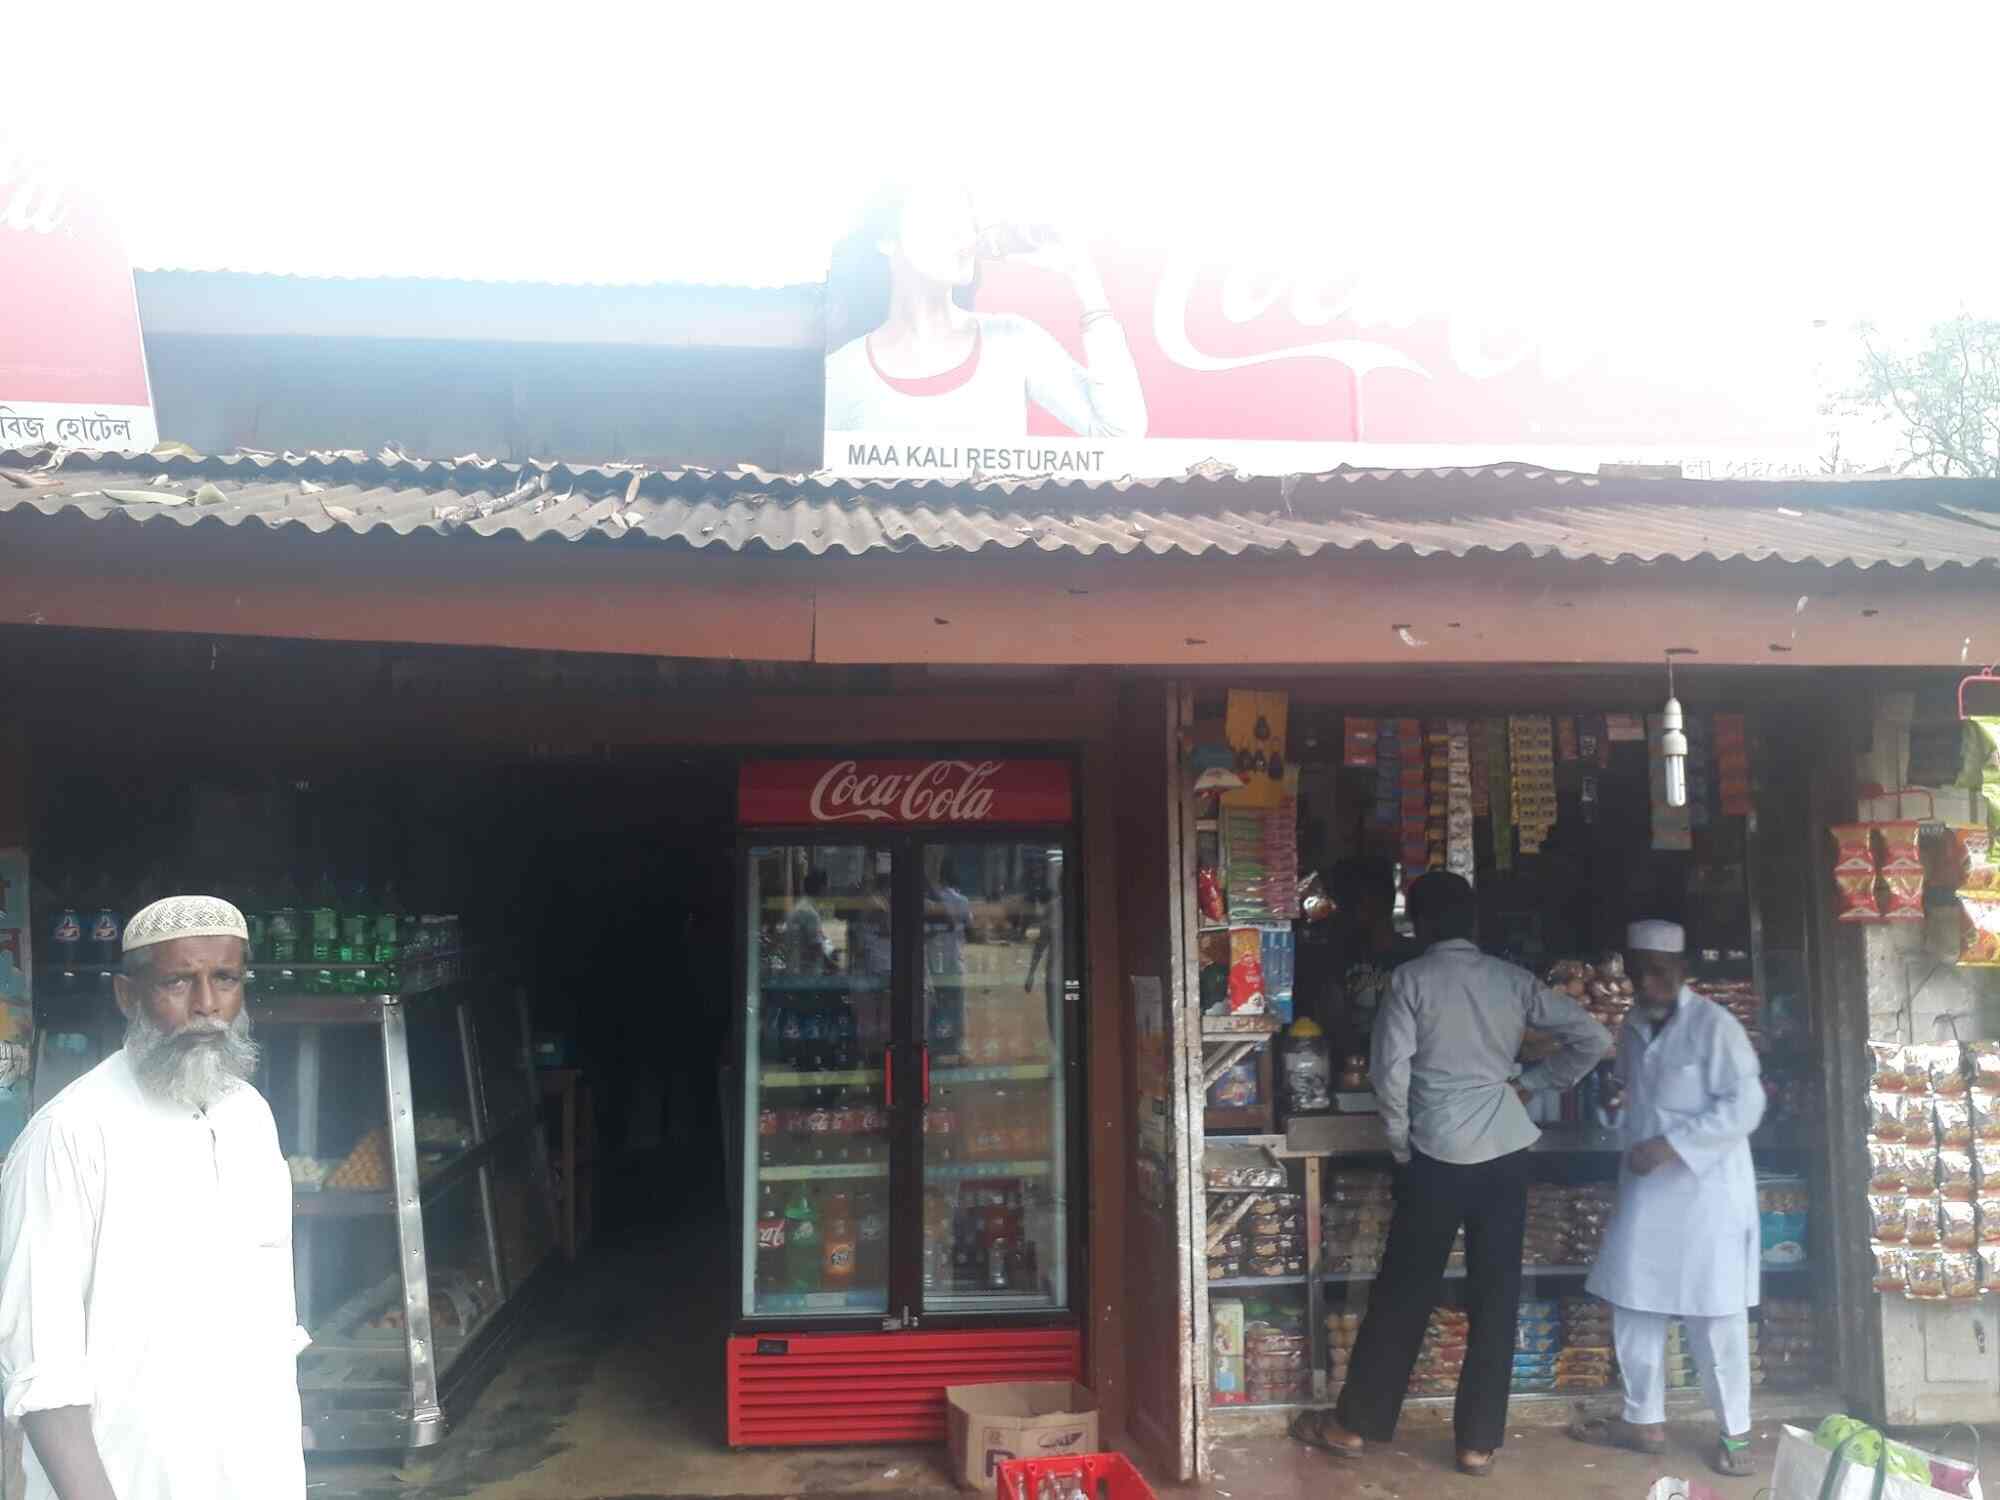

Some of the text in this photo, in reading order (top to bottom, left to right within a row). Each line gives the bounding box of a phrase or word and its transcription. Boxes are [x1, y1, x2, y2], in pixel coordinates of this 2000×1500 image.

[56, 411, 131, 442] হোটেল
[848, 445, 1104, 472] MAA KALI RESTURANT
